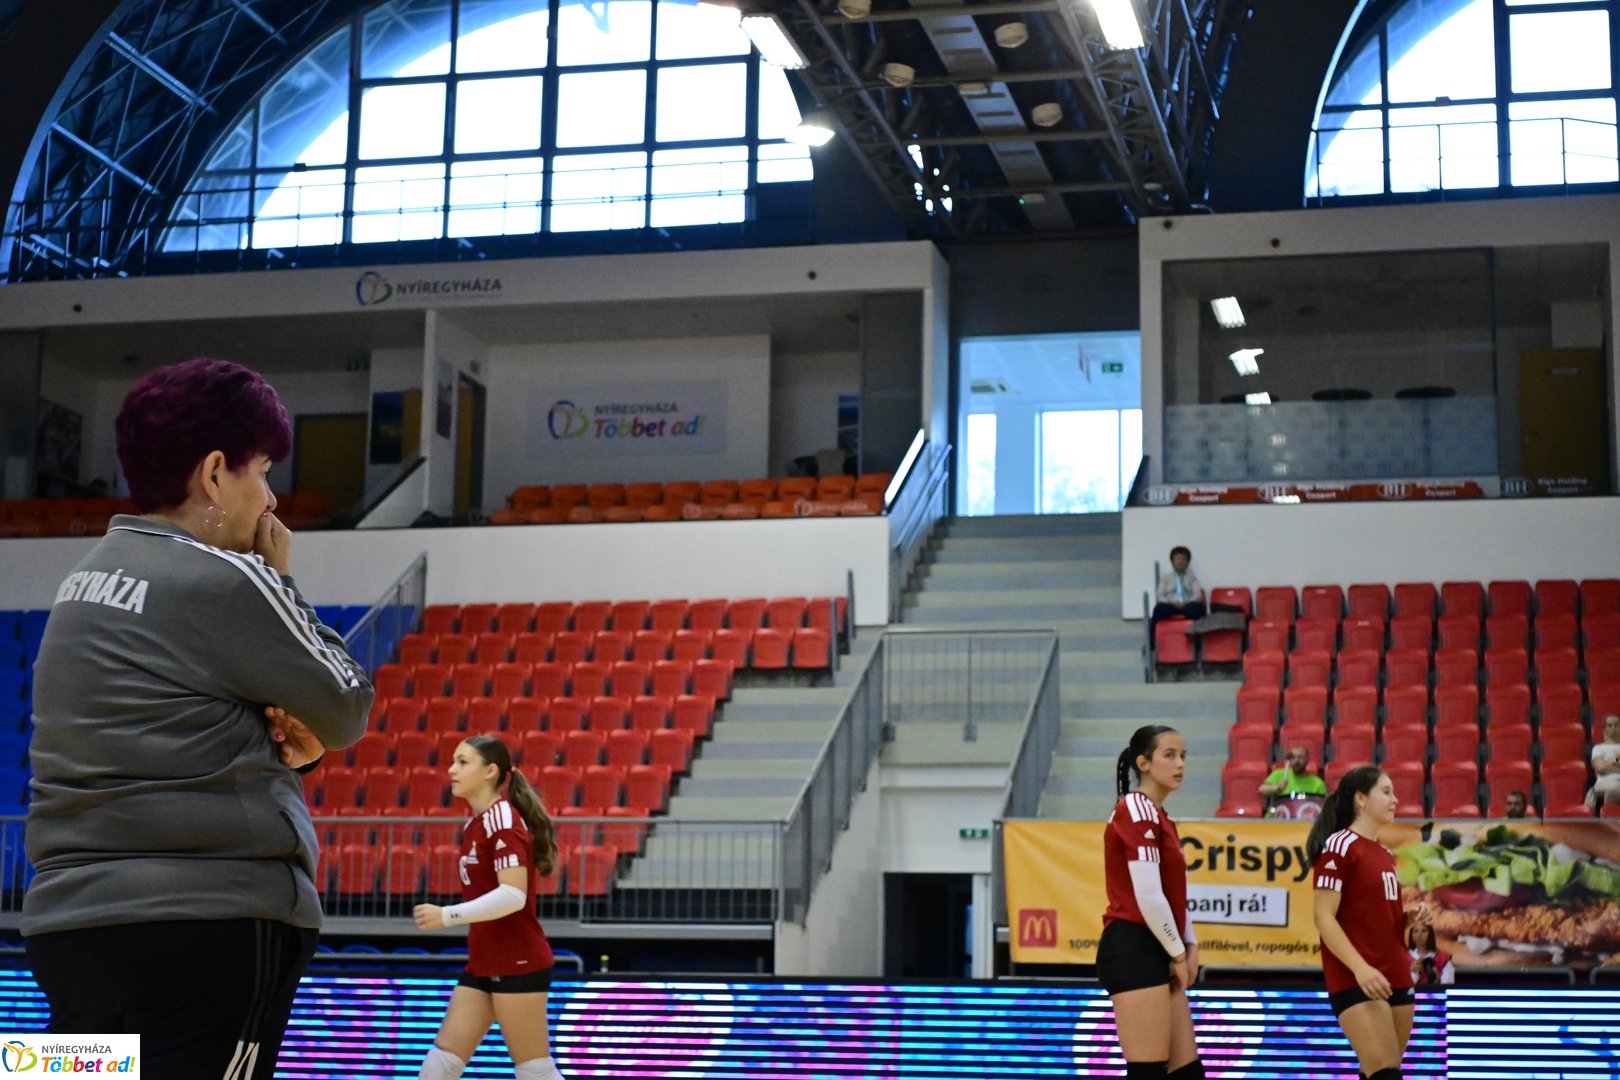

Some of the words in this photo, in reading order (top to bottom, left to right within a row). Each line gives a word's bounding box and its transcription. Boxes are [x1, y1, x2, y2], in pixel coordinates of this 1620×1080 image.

[397, 277, 502, 294] NYÍREGYHÁZA
[595, 416, 666, 438] Többet
[1179, 834, 1312, 883] Crispy
[1382, 871, 1399, 901] 10
[1239, 895, 1267, 912] rá!
